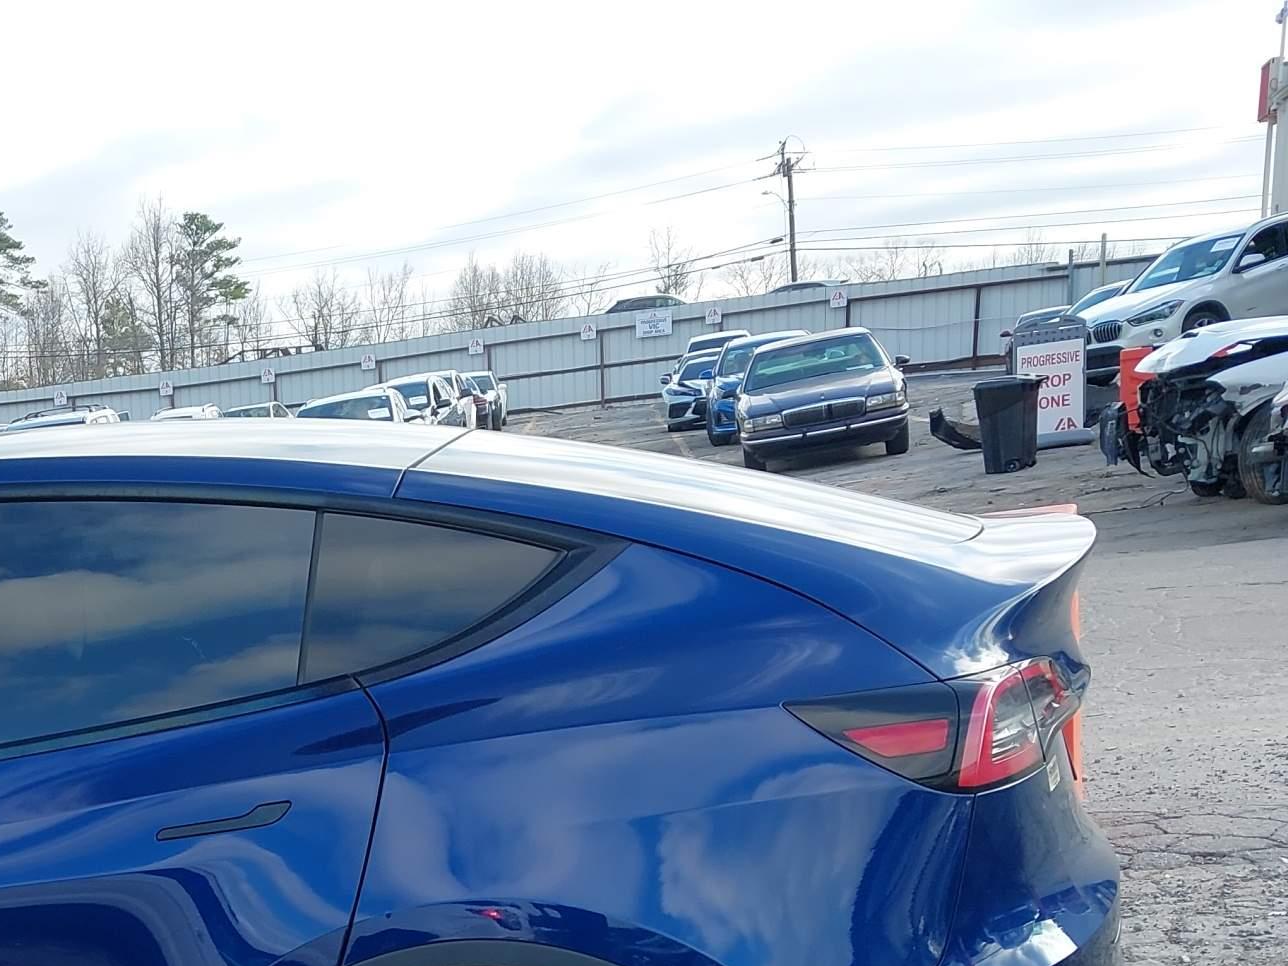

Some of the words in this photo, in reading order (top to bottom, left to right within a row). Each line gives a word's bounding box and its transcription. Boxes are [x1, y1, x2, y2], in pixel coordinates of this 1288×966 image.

[1021, 350, 1081, 369] PROGRESSIVE
[1039, 373, 1072, 389] ROP
[1038, 393, 1071, 410] ONE
